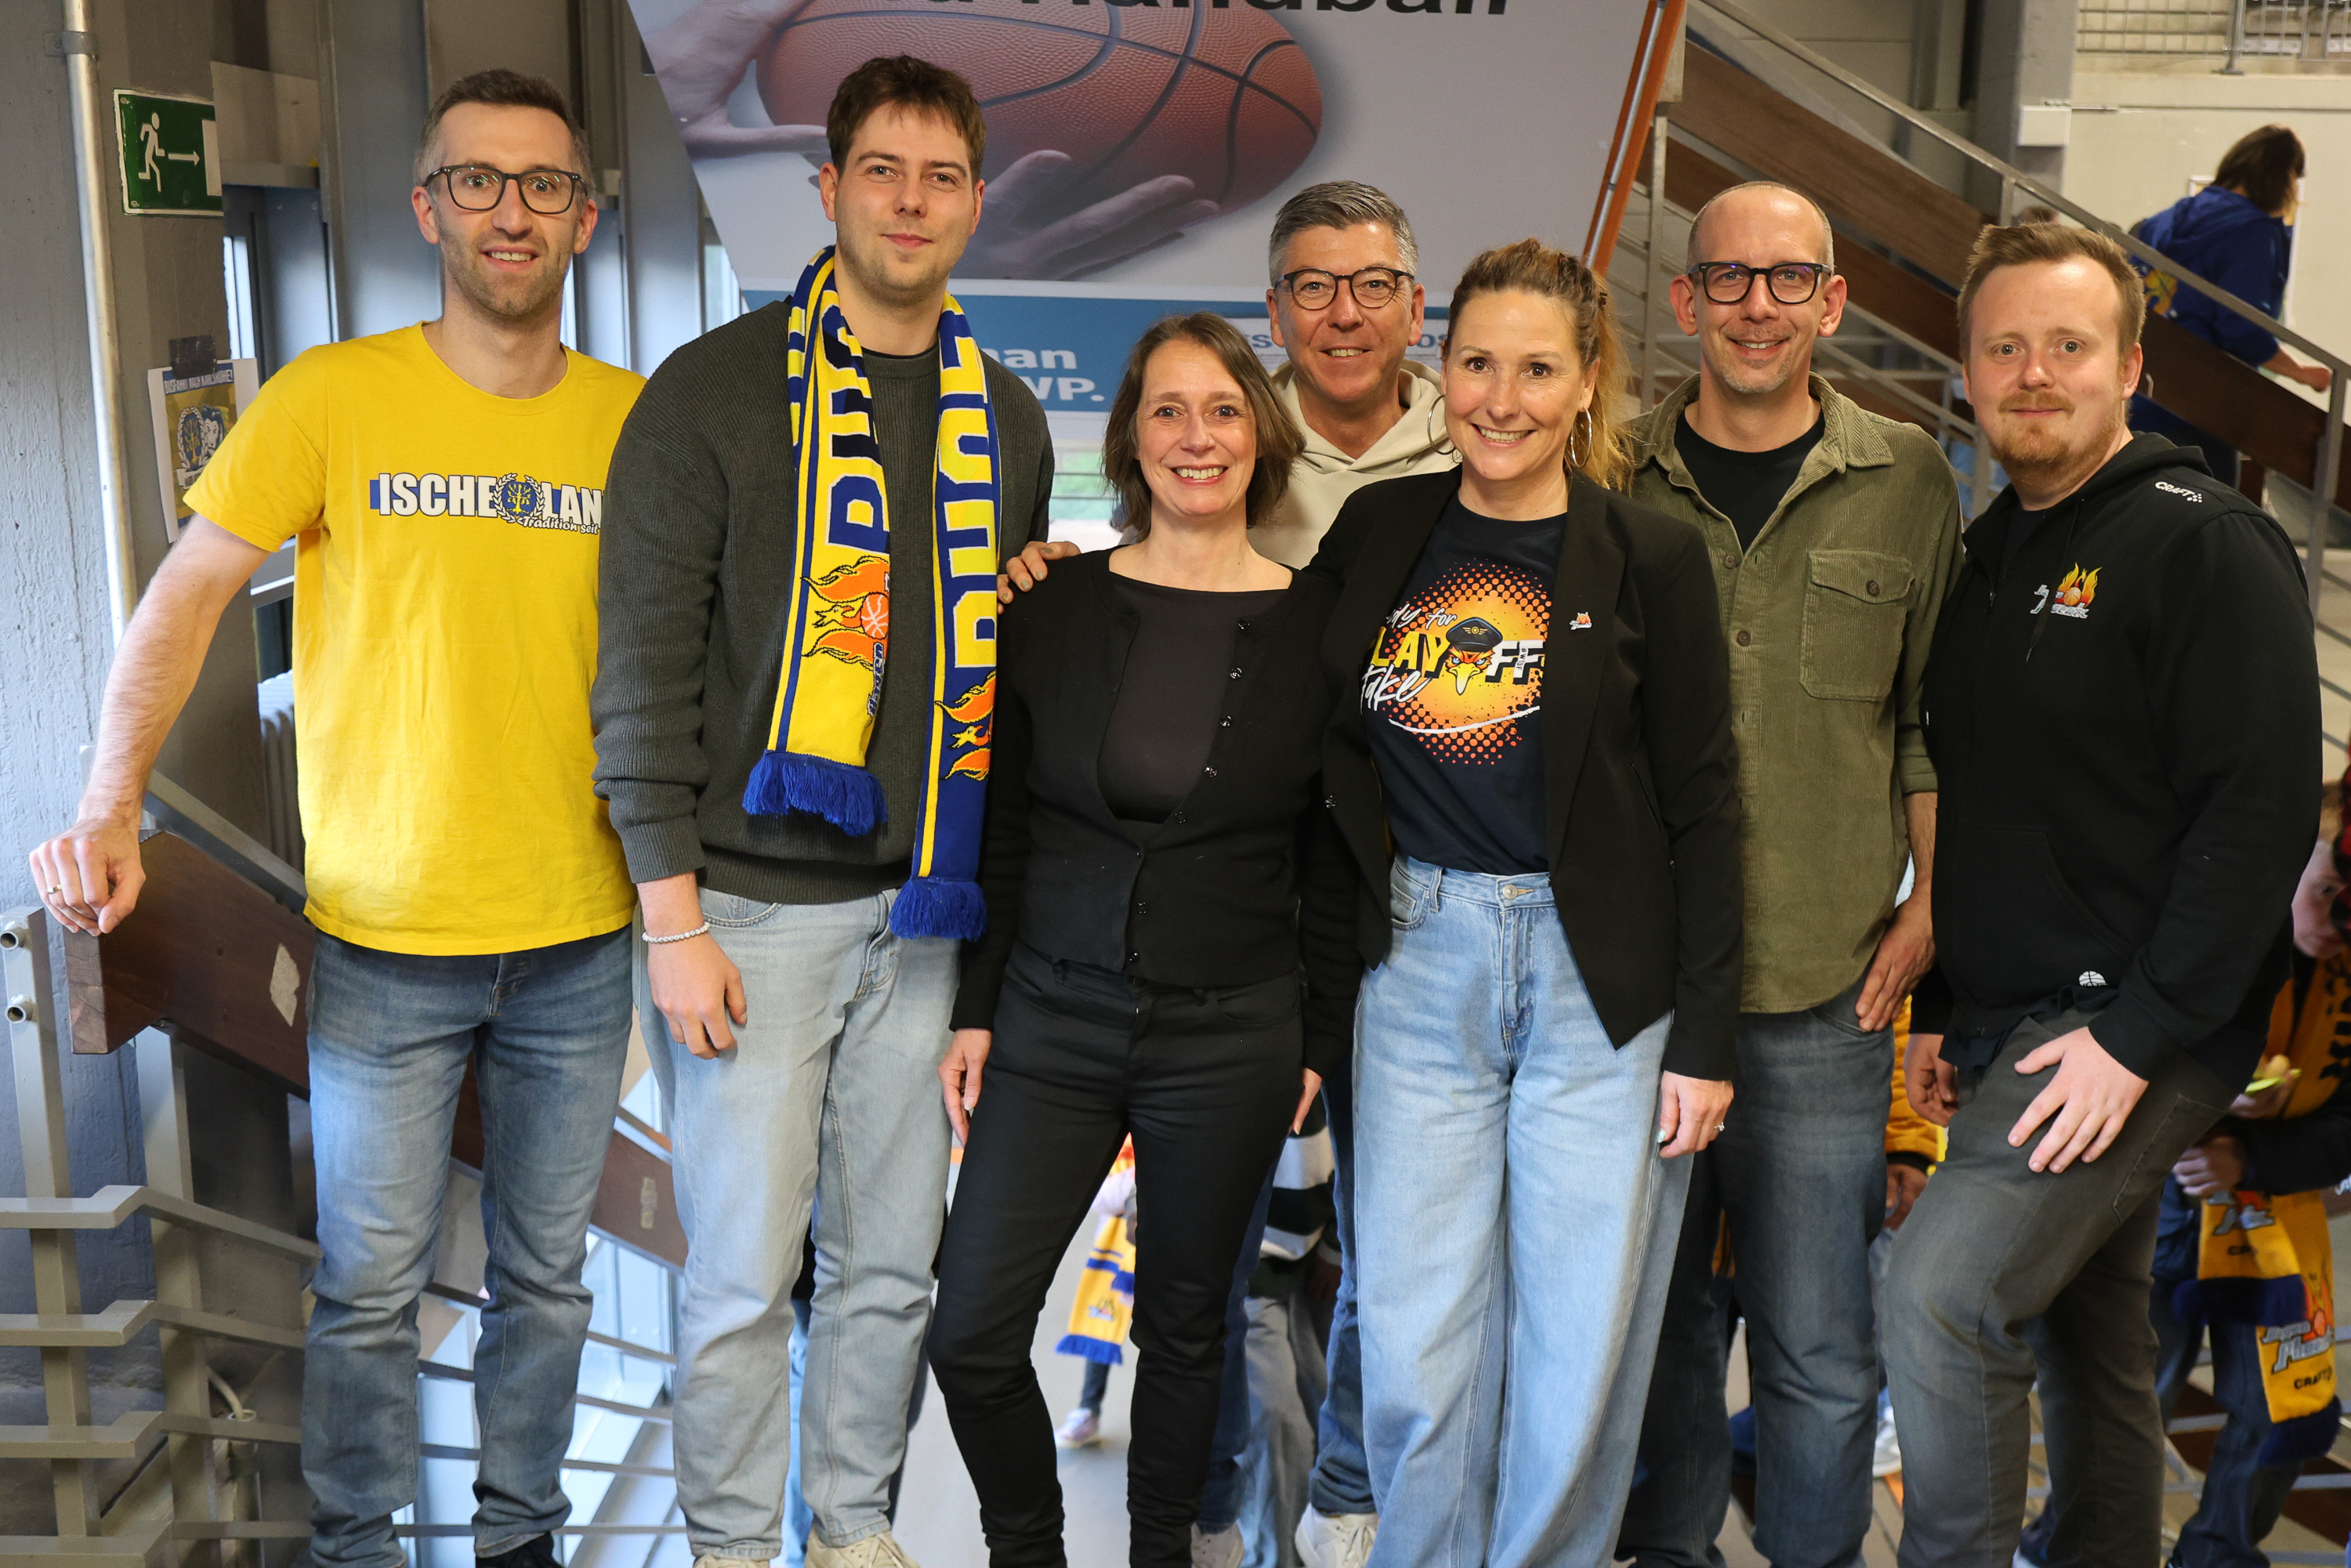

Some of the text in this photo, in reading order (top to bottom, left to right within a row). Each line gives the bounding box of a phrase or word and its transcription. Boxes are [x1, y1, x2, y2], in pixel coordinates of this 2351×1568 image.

[379, 472, 602, 528] ISCHE LAN
[2154, 481, 2196, 497] CRAFT
[522, 515, 600, 534] Tradition seit
[1425, 607, 1458, 630] for
[1369, 625, 1451, 672] LAY
